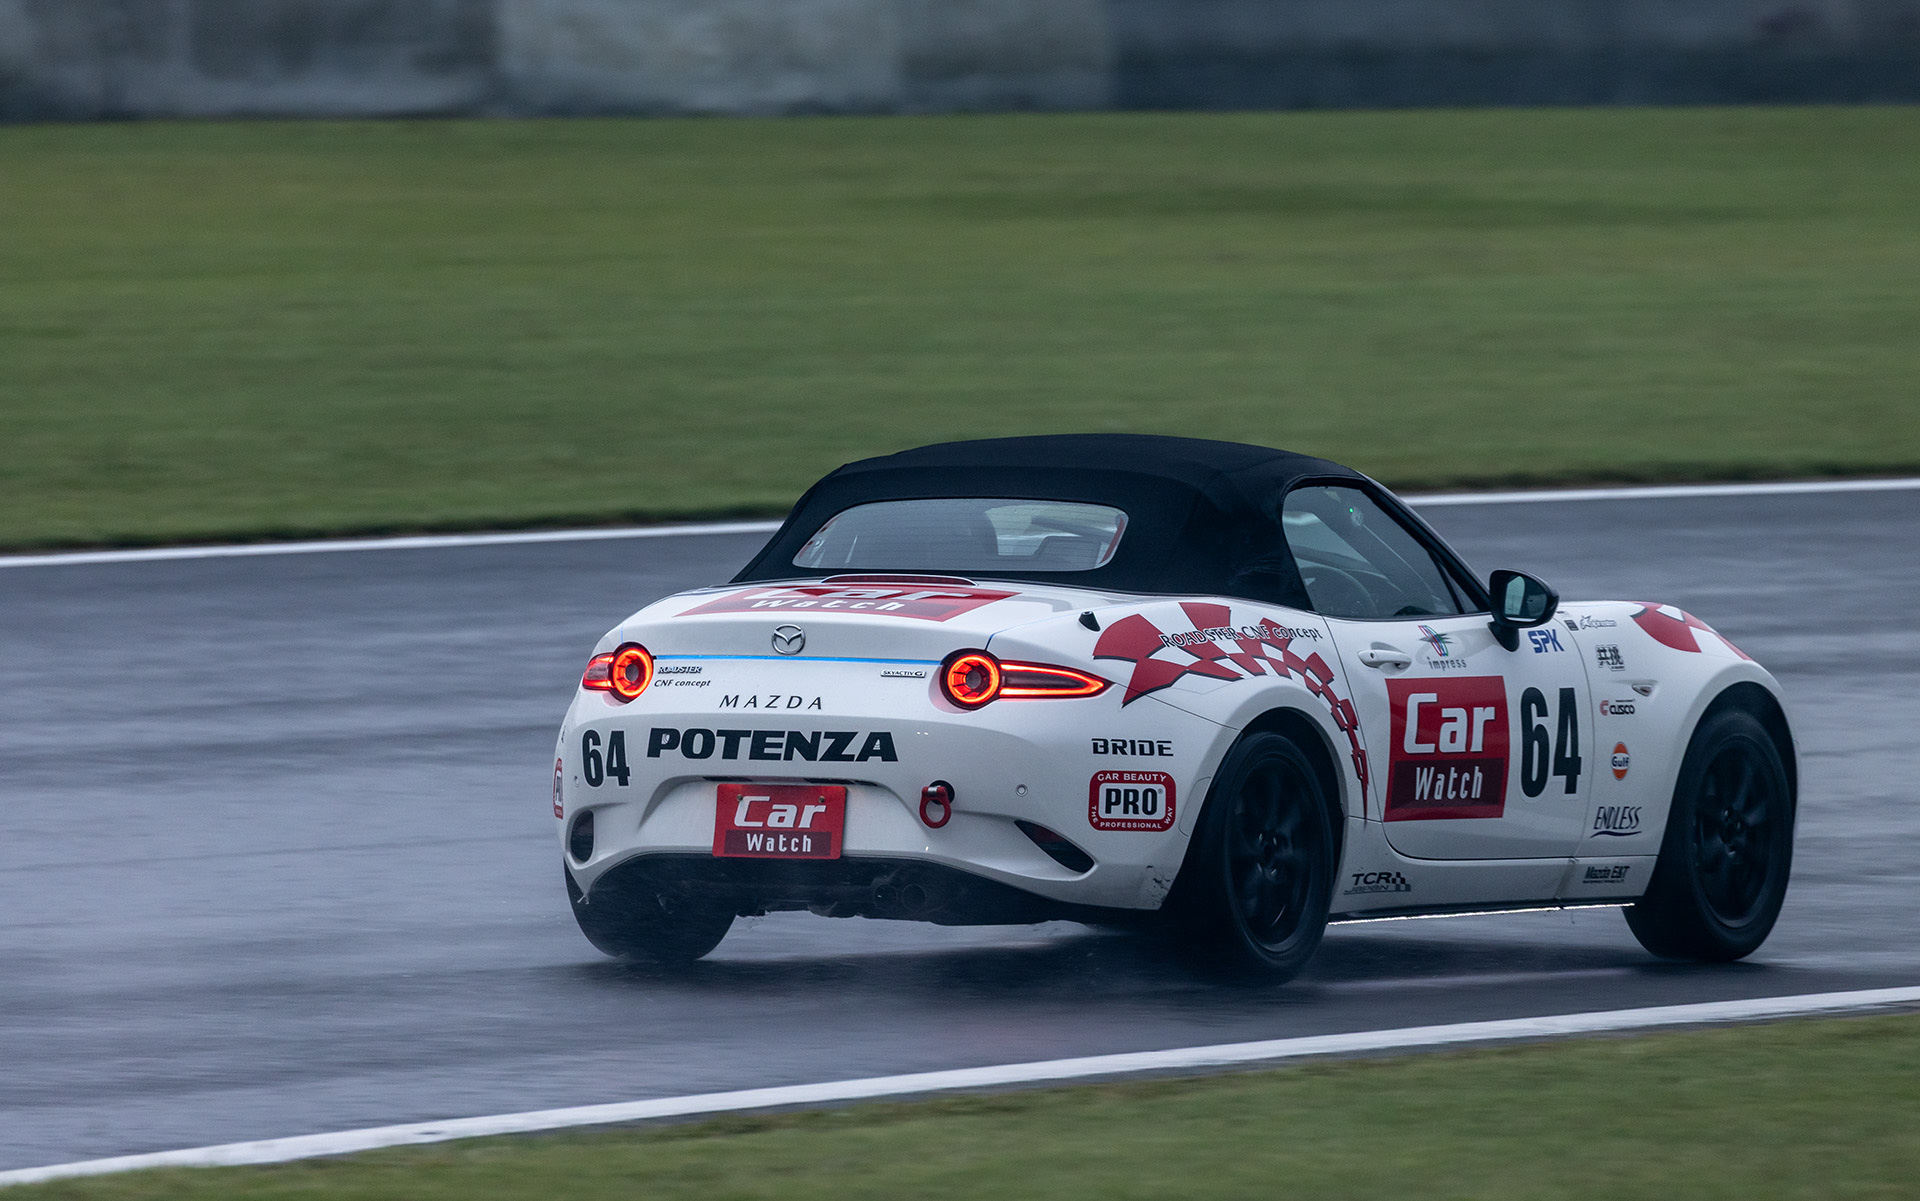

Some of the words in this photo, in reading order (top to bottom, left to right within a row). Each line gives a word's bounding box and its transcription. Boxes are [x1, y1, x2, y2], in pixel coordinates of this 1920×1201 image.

[743, 586, 973, 601] Car
[750, 600, 905, 612] Watch
[1160, 626, 1239, 648] ROADSTER
[1241, 624, 1270, 640] CNF
[1273, 626, 1323, 642] concept
[1527, 629, 1564, 654] SPK
[658, 665, 702, 675] ROADSTER
[1427, 656, 1467, 671] impress
[654, 679, 674, 688] CNF
[675, 680, 711, 689] concept
[719, 694, 822, 710] MAZDA
[1403, 692, 1495, 754] Car
[647, 727, 899, 762] POTENZA
[1091, 738, 1174, 757] BRIDE
[1520, 686, 1582, 798] 64
[582, 729, 631, 788] 64
[1611, 755, 1630, 767] Gulf
[1097, 772, 1119, 781] CAR
[1123, 773, 1167, 782] BEAUTY
[1415, 765, 1484, 800] Watch
[734, 795, 827, 829] Car
[1091, 805, 1099, 823] THE
[1099, 821, 1162, 829] PROFESSIONAL
[1163, 806, 1173, 825] WAY
[1593, 806, 1642, 829] ENDLESS
[746, 833, 812, 853] Watch
[1352, 872, 1392, 886] TCR
